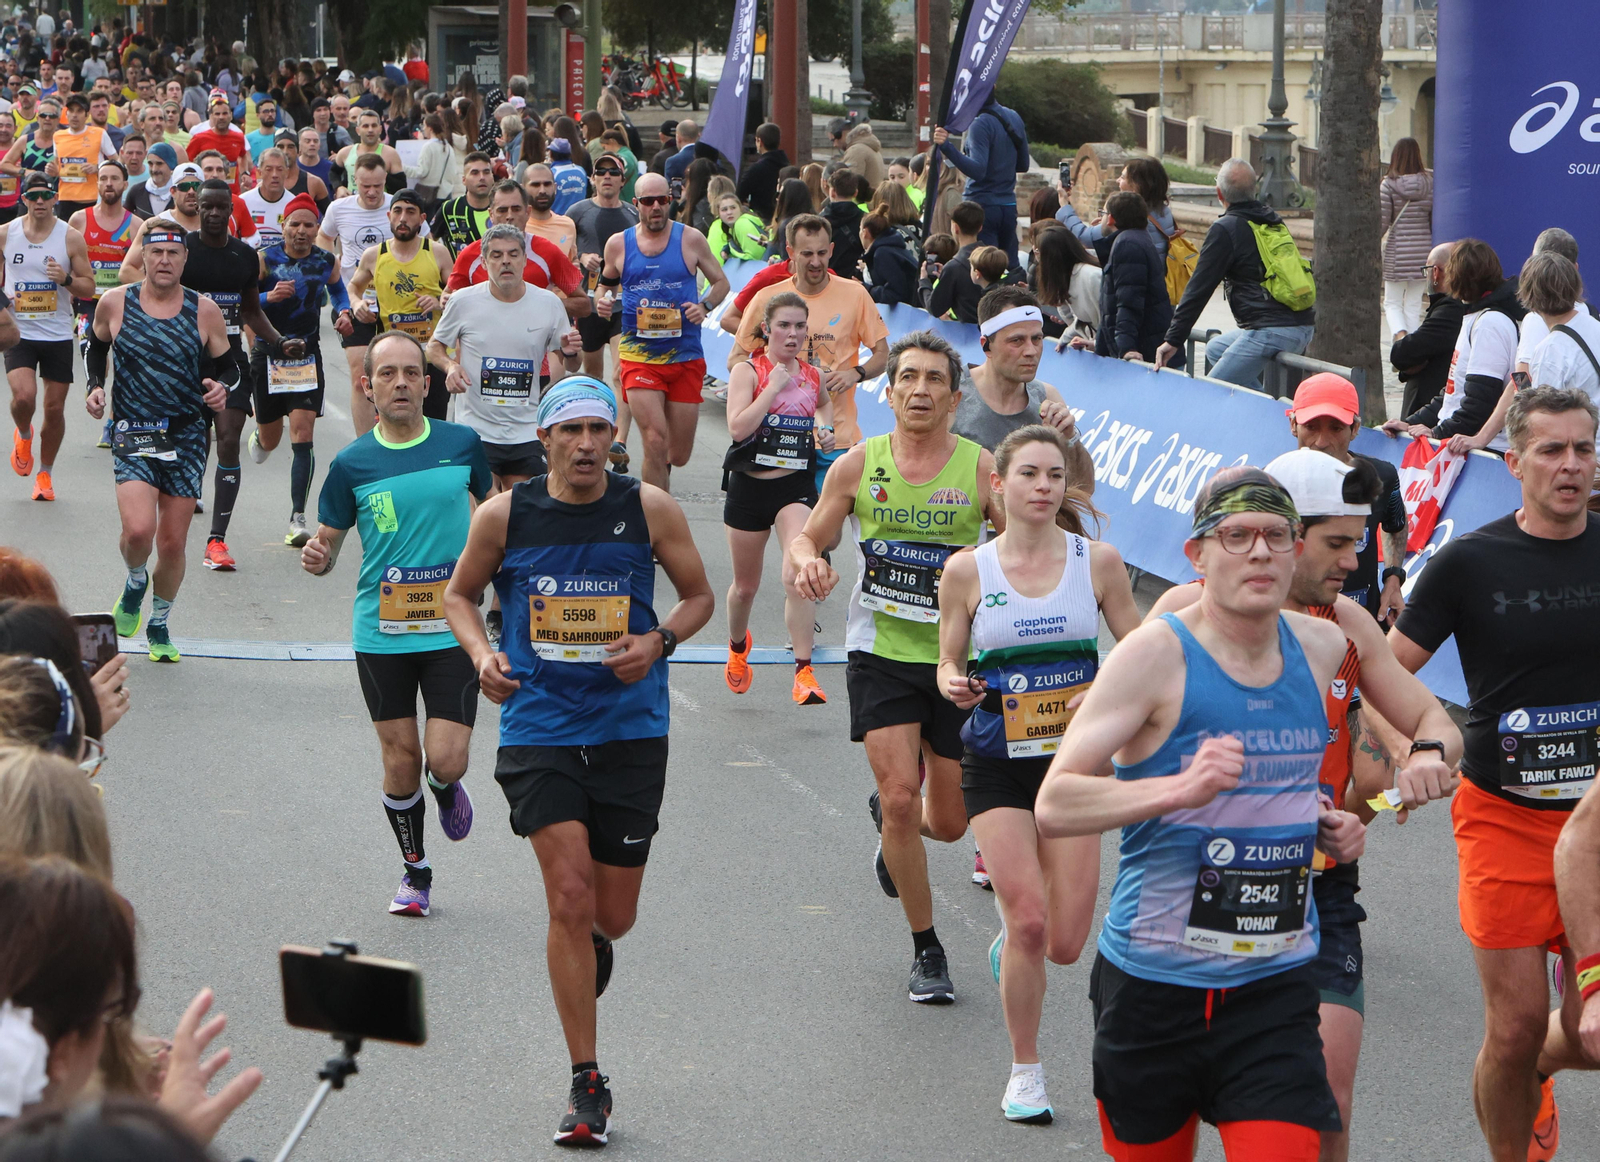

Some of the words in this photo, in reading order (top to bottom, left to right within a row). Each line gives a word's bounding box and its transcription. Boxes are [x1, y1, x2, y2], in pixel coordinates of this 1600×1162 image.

[403, 314, 427, 322] ZURICH
[499, 361, 529, 370] ZURICH
[498, 376, 517, 386] 3456
[482, 387, 503, 396] SERGIO
[504, 388, 529, 397] GÁNDARA
[783, 418, 810, 427] ZURICH
[779, 434, 798, 445] 2894
[776, 448, 798, 457] SARAH
[873, 505, 957, 529] melgar
[925, 528, 954, 536] eléctricas
[892, 546, 940, 563] ZURICH
[407, 567, 448, 581] ZURICH
[889, 569, 917, 586] 3116
[563, 581, 618, 592] ZURICH
[406, 592, 433, 603] 3928
[869, 582, 933, 606] PACOPORTERO
[405, 610, 435, 619] JAVIER
[563, 608, 596, 622] 5598
[1013, 615, 1067, 628] clapham
[536, 629, 559, 641] MED
[1017, 624, 1065, 638] chasers
[1034, 669, 1084, 687] ZURICH
[1036, 700, 1067, 715] 4471
[1536, 708, 1598, 726] ZURICH
[1538, 741, 1576, 760] 3244
[1520, 769, 1557, 783] TARIK
[1559, 764, 1595, 780] FAWZI
[1243, 843, 1304, 861] ZURICH
[1240, 884, 1279, 904] 2542
[1236, 915, 1278, 931] YOHAY
